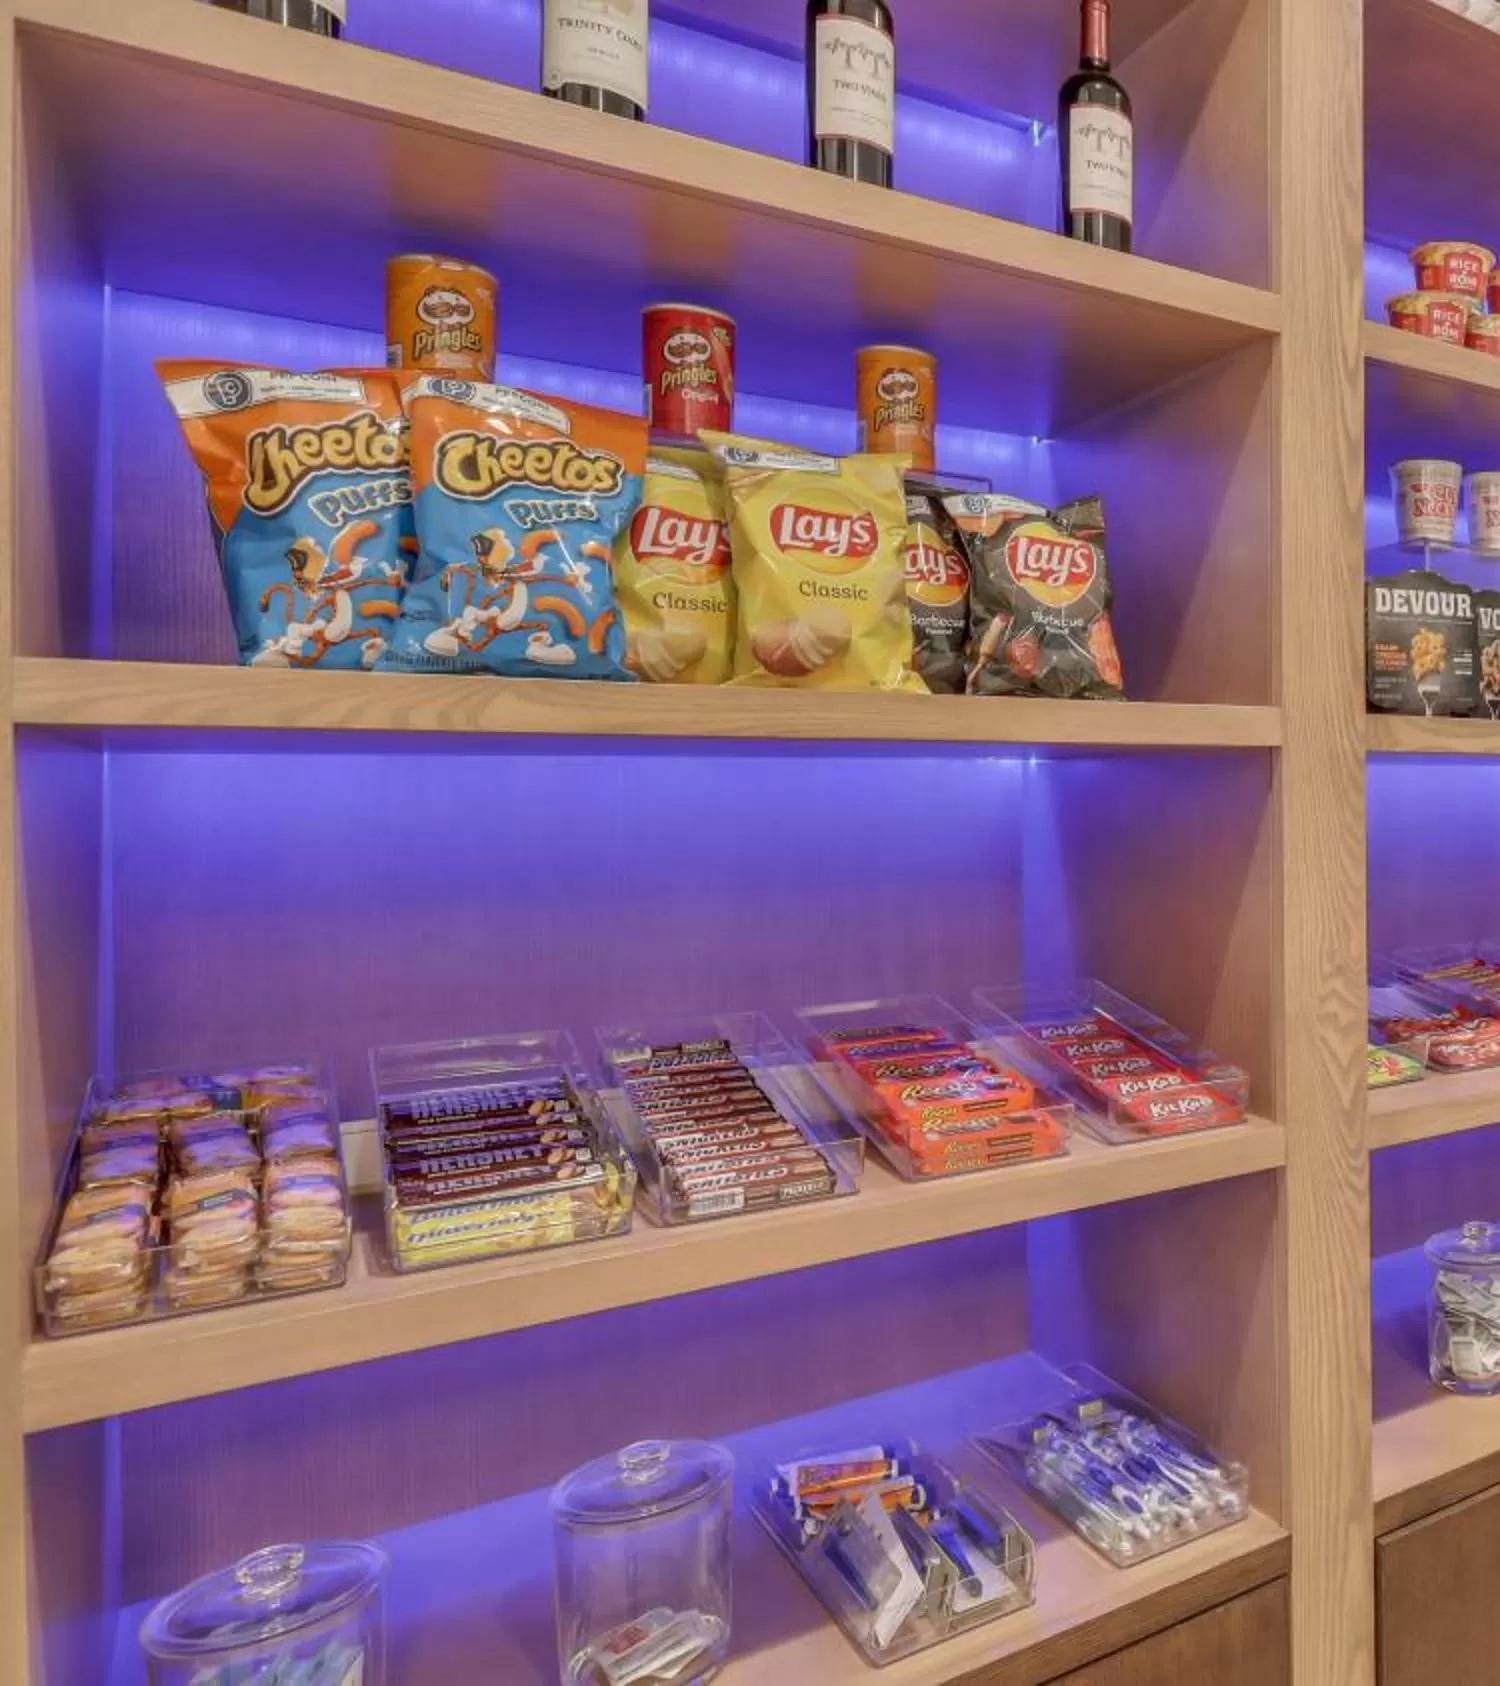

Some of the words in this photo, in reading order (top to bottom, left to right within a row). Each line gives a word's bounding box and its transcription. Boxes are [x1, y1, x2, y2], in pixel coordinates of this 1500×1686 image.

[412, 323, 481, 360] Pringles
[661, 363, 718, 396] Pringles
[437, 432, 622, 497] Cheetos
[779, 507, 872, 557] Lay's
[1016, 537, 1089, 586] Lay's
[652, 591, 728, 614] Classic
[799, 580, 869, 601] Classic
[1375, 587, 1474, 618] DEVOUR
